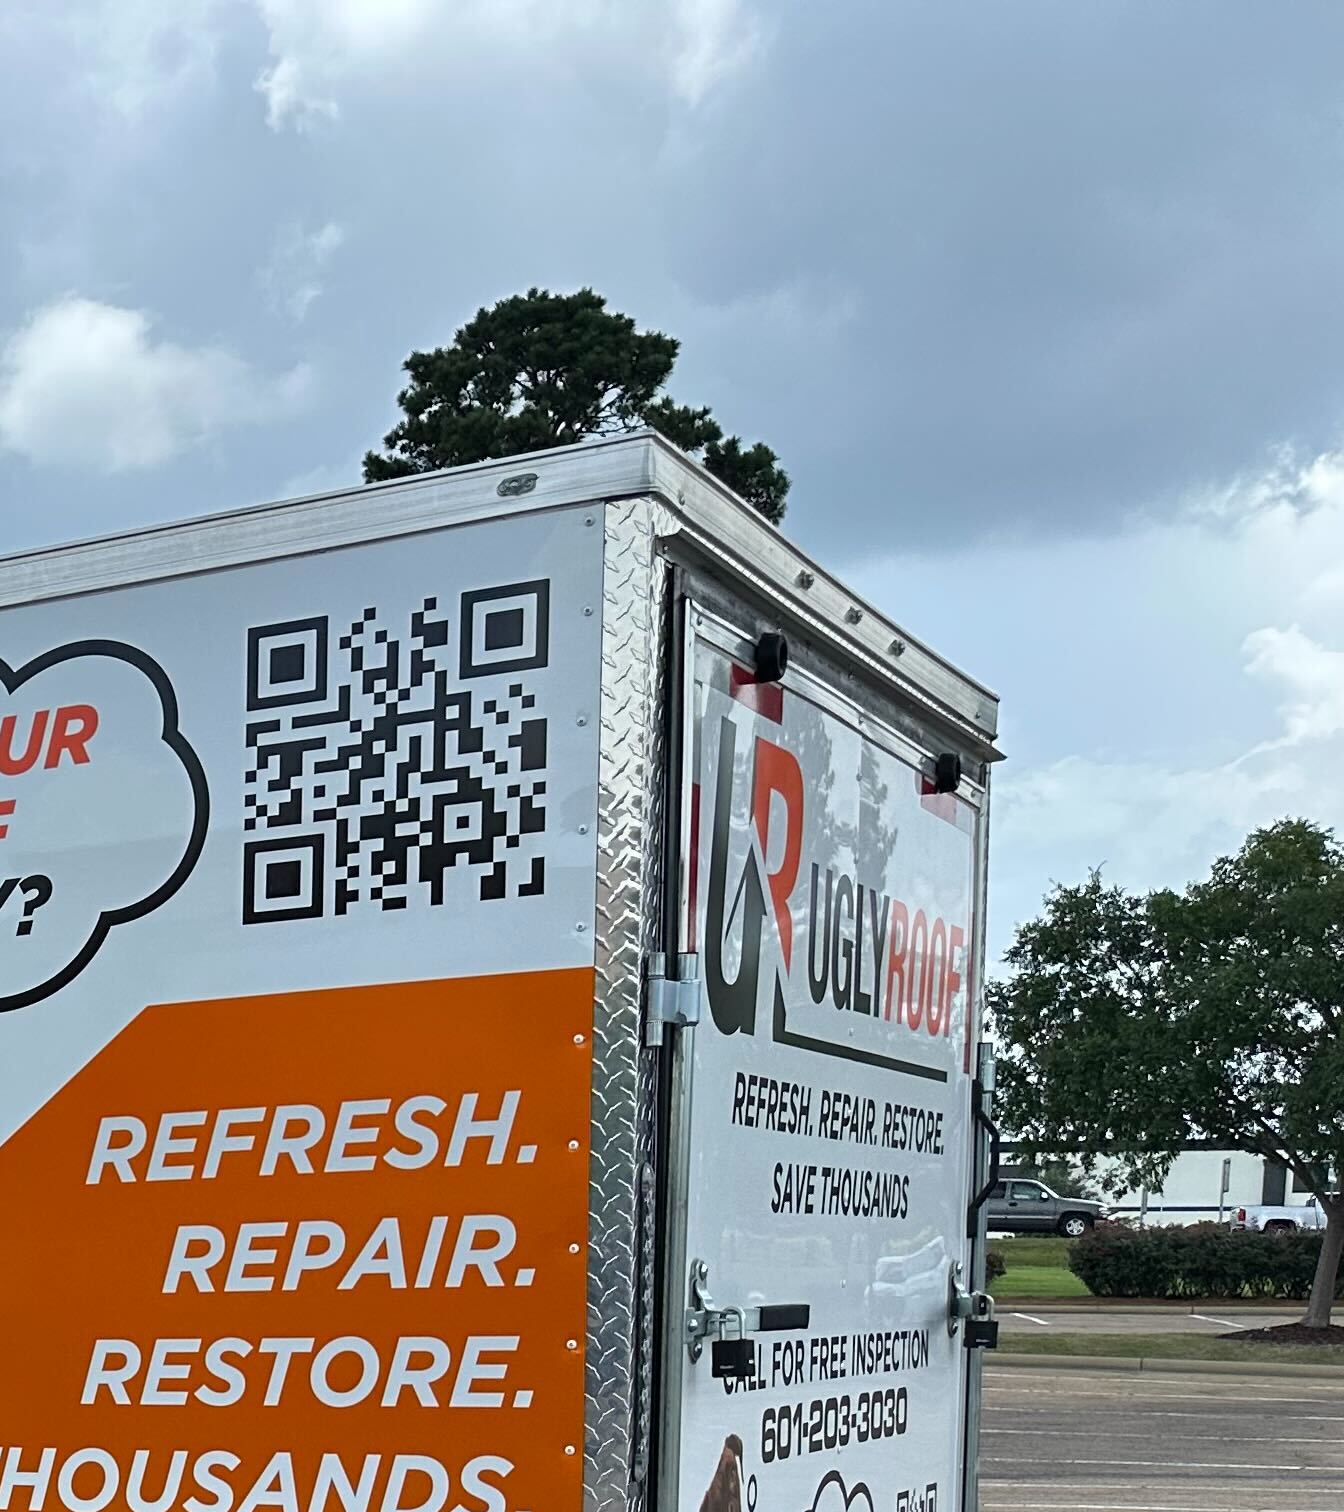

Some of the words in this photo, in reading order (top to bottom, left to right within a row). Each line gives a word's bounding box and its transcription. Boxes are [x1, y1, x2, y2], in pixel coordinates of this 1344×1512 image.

[807, 862, 964, 1037] UGLYROOF
[85, 1089, 539, 1185] REFRESH.
[732, 1071, 812, 1137] REFRESH.
[818, 1090, 877, 1146] REPAIR.
[882, 1102, 945, 1156] RESTORE.
[771, 1162, 817, 1214] SAVE
[821, 1166, 910, 1219] THOUSANDS
[162, 1213, 536, 1294] REPAIR.
[80, 1335, 535, 1409] RESTORE.
[772, 1339, 805, 1388] FOR
[810, 1335, 848, 1382] FREE
[852, 1328, 929, 1376] INSPECTION
[762, 1386, 908, 1464] 601-203-3030
